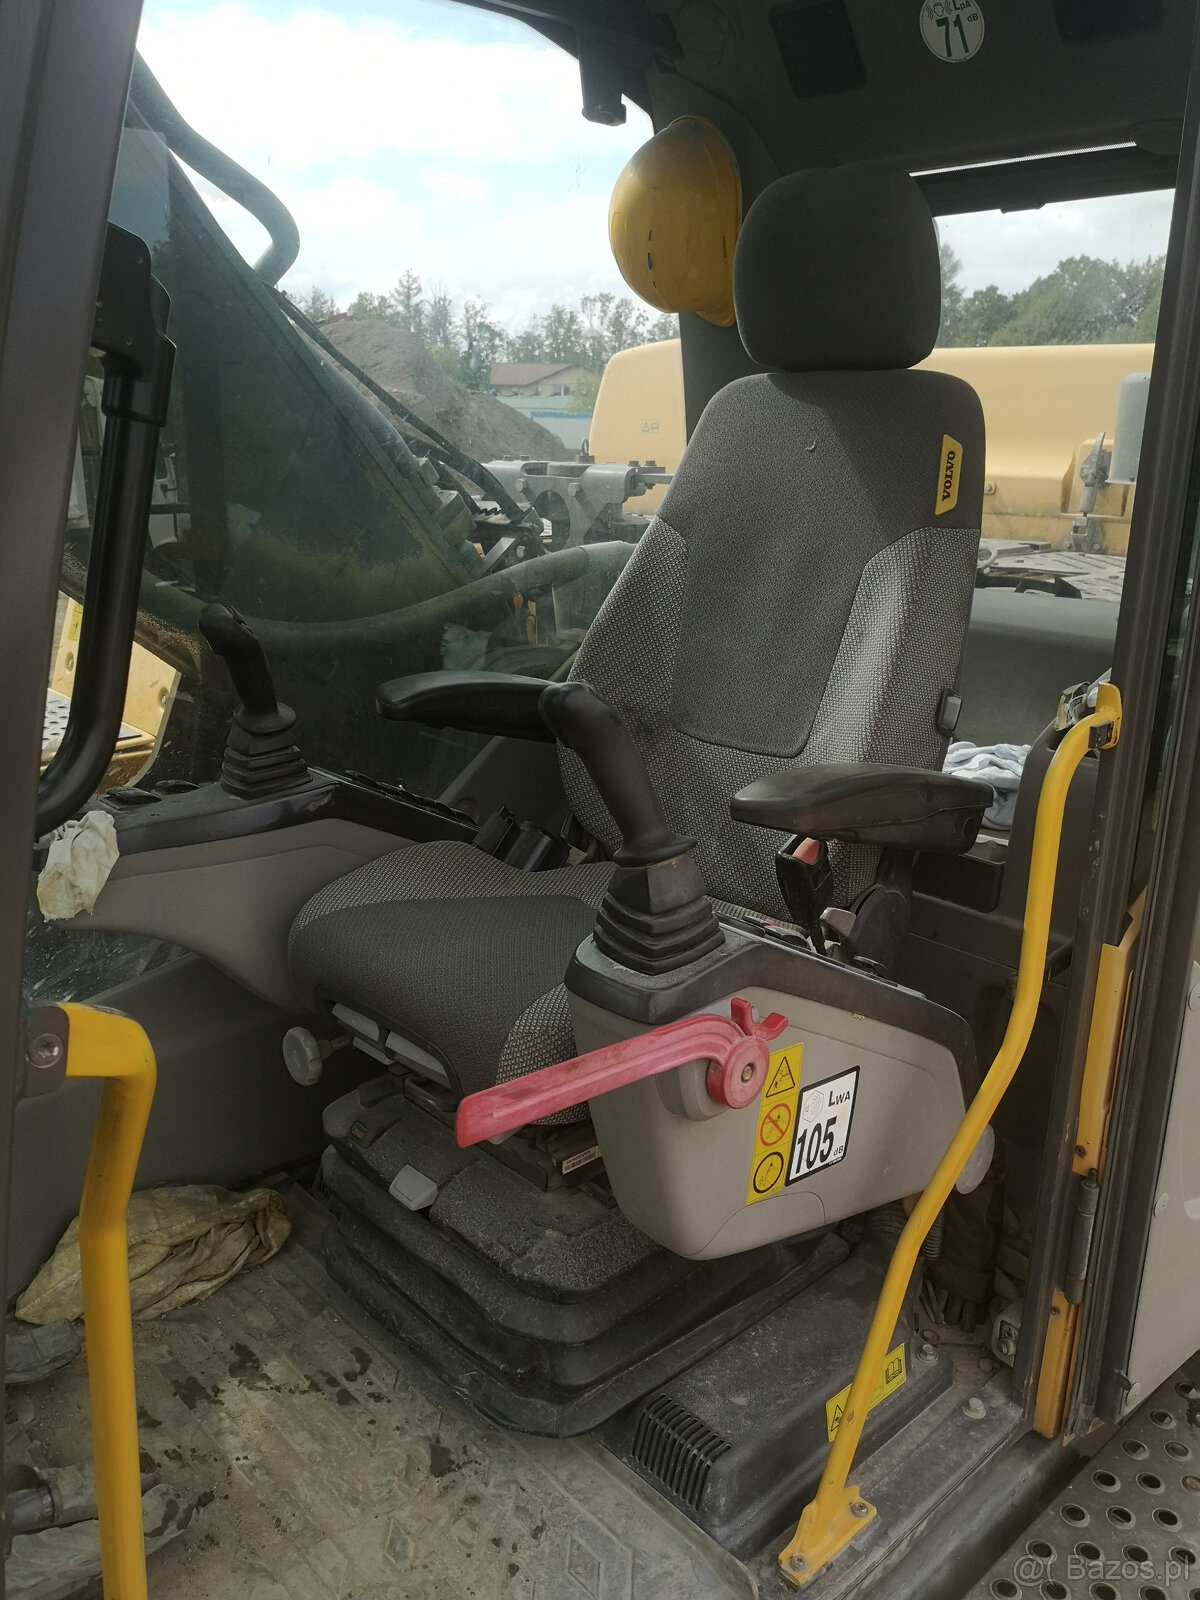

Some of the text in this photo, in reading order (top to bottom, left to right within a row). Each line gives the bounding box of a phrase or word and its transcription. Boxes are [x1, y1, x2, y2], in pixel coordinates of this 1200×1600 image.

[936, 13, 979, 57] 71 dB
[942, 451, 956, 502] VOLVO
[796, 1116, 844, 1174] 105 dB
